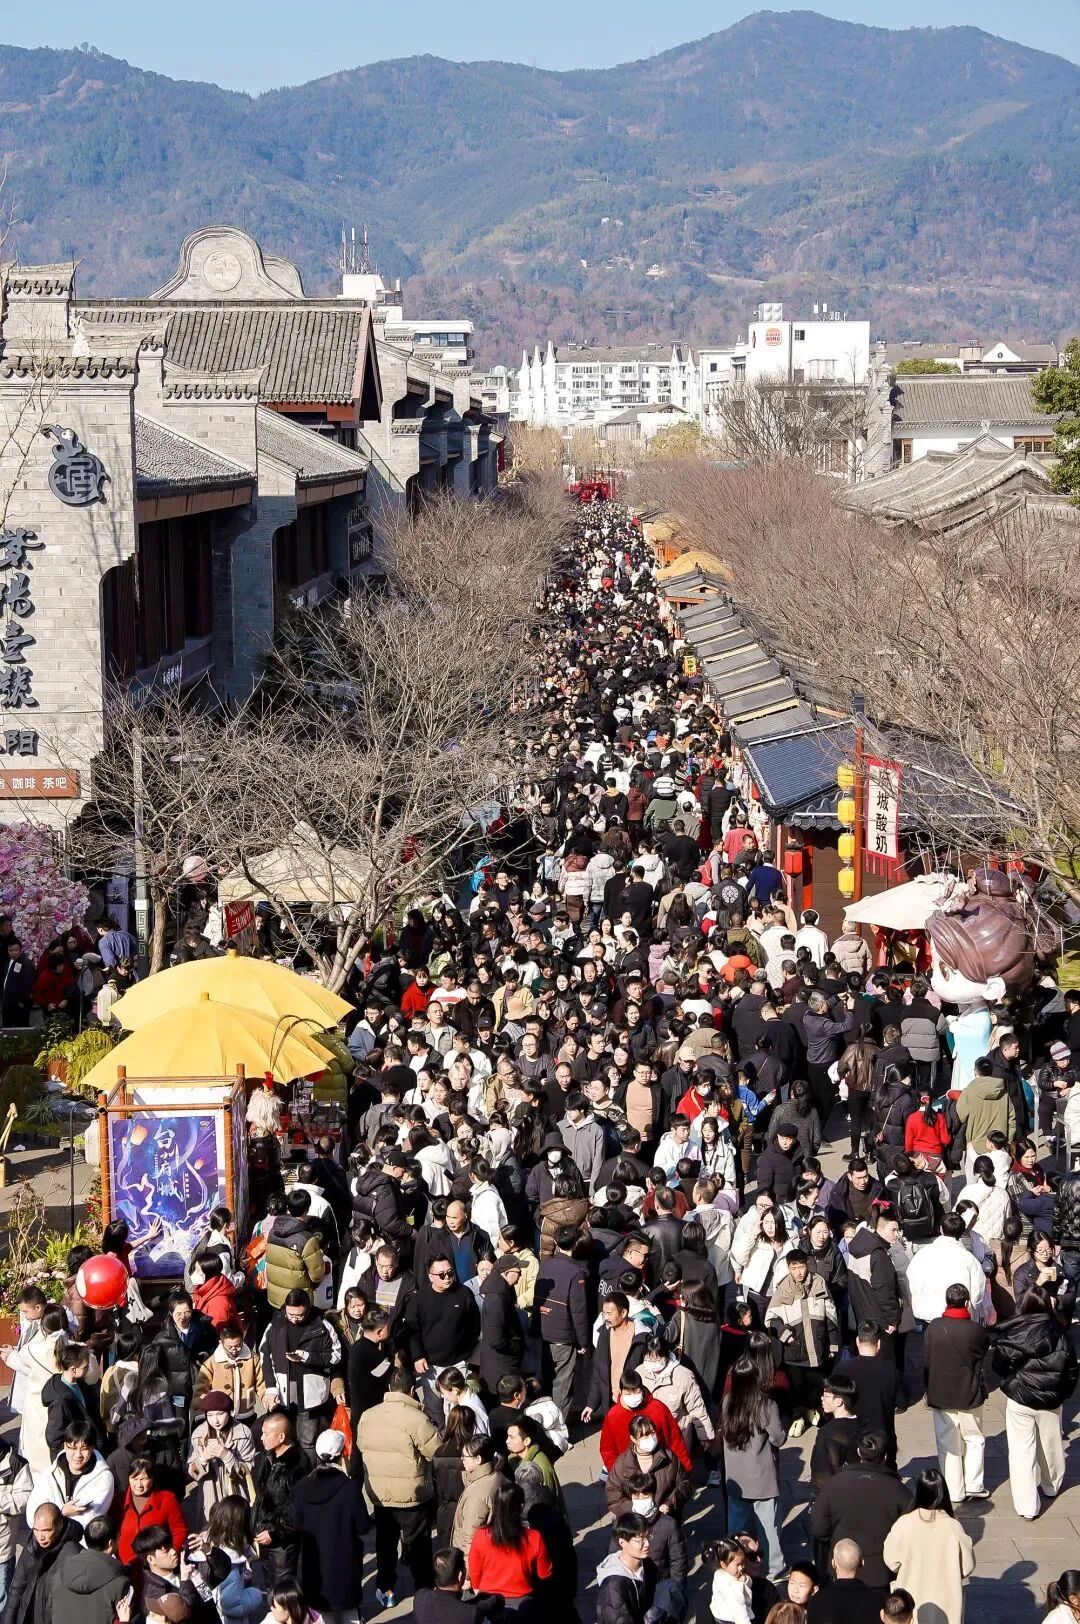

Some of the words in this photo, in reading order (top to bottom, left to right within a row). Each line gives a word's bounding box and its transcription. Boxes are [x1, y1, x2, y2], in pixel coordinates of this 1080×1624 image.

[0, 730, 38, 756] 阳
[12, 777, 36, 789] 咖啡
[43, 776, 67, 789] 茶吧
[152, 1125, 184, 1202] 台州府城
